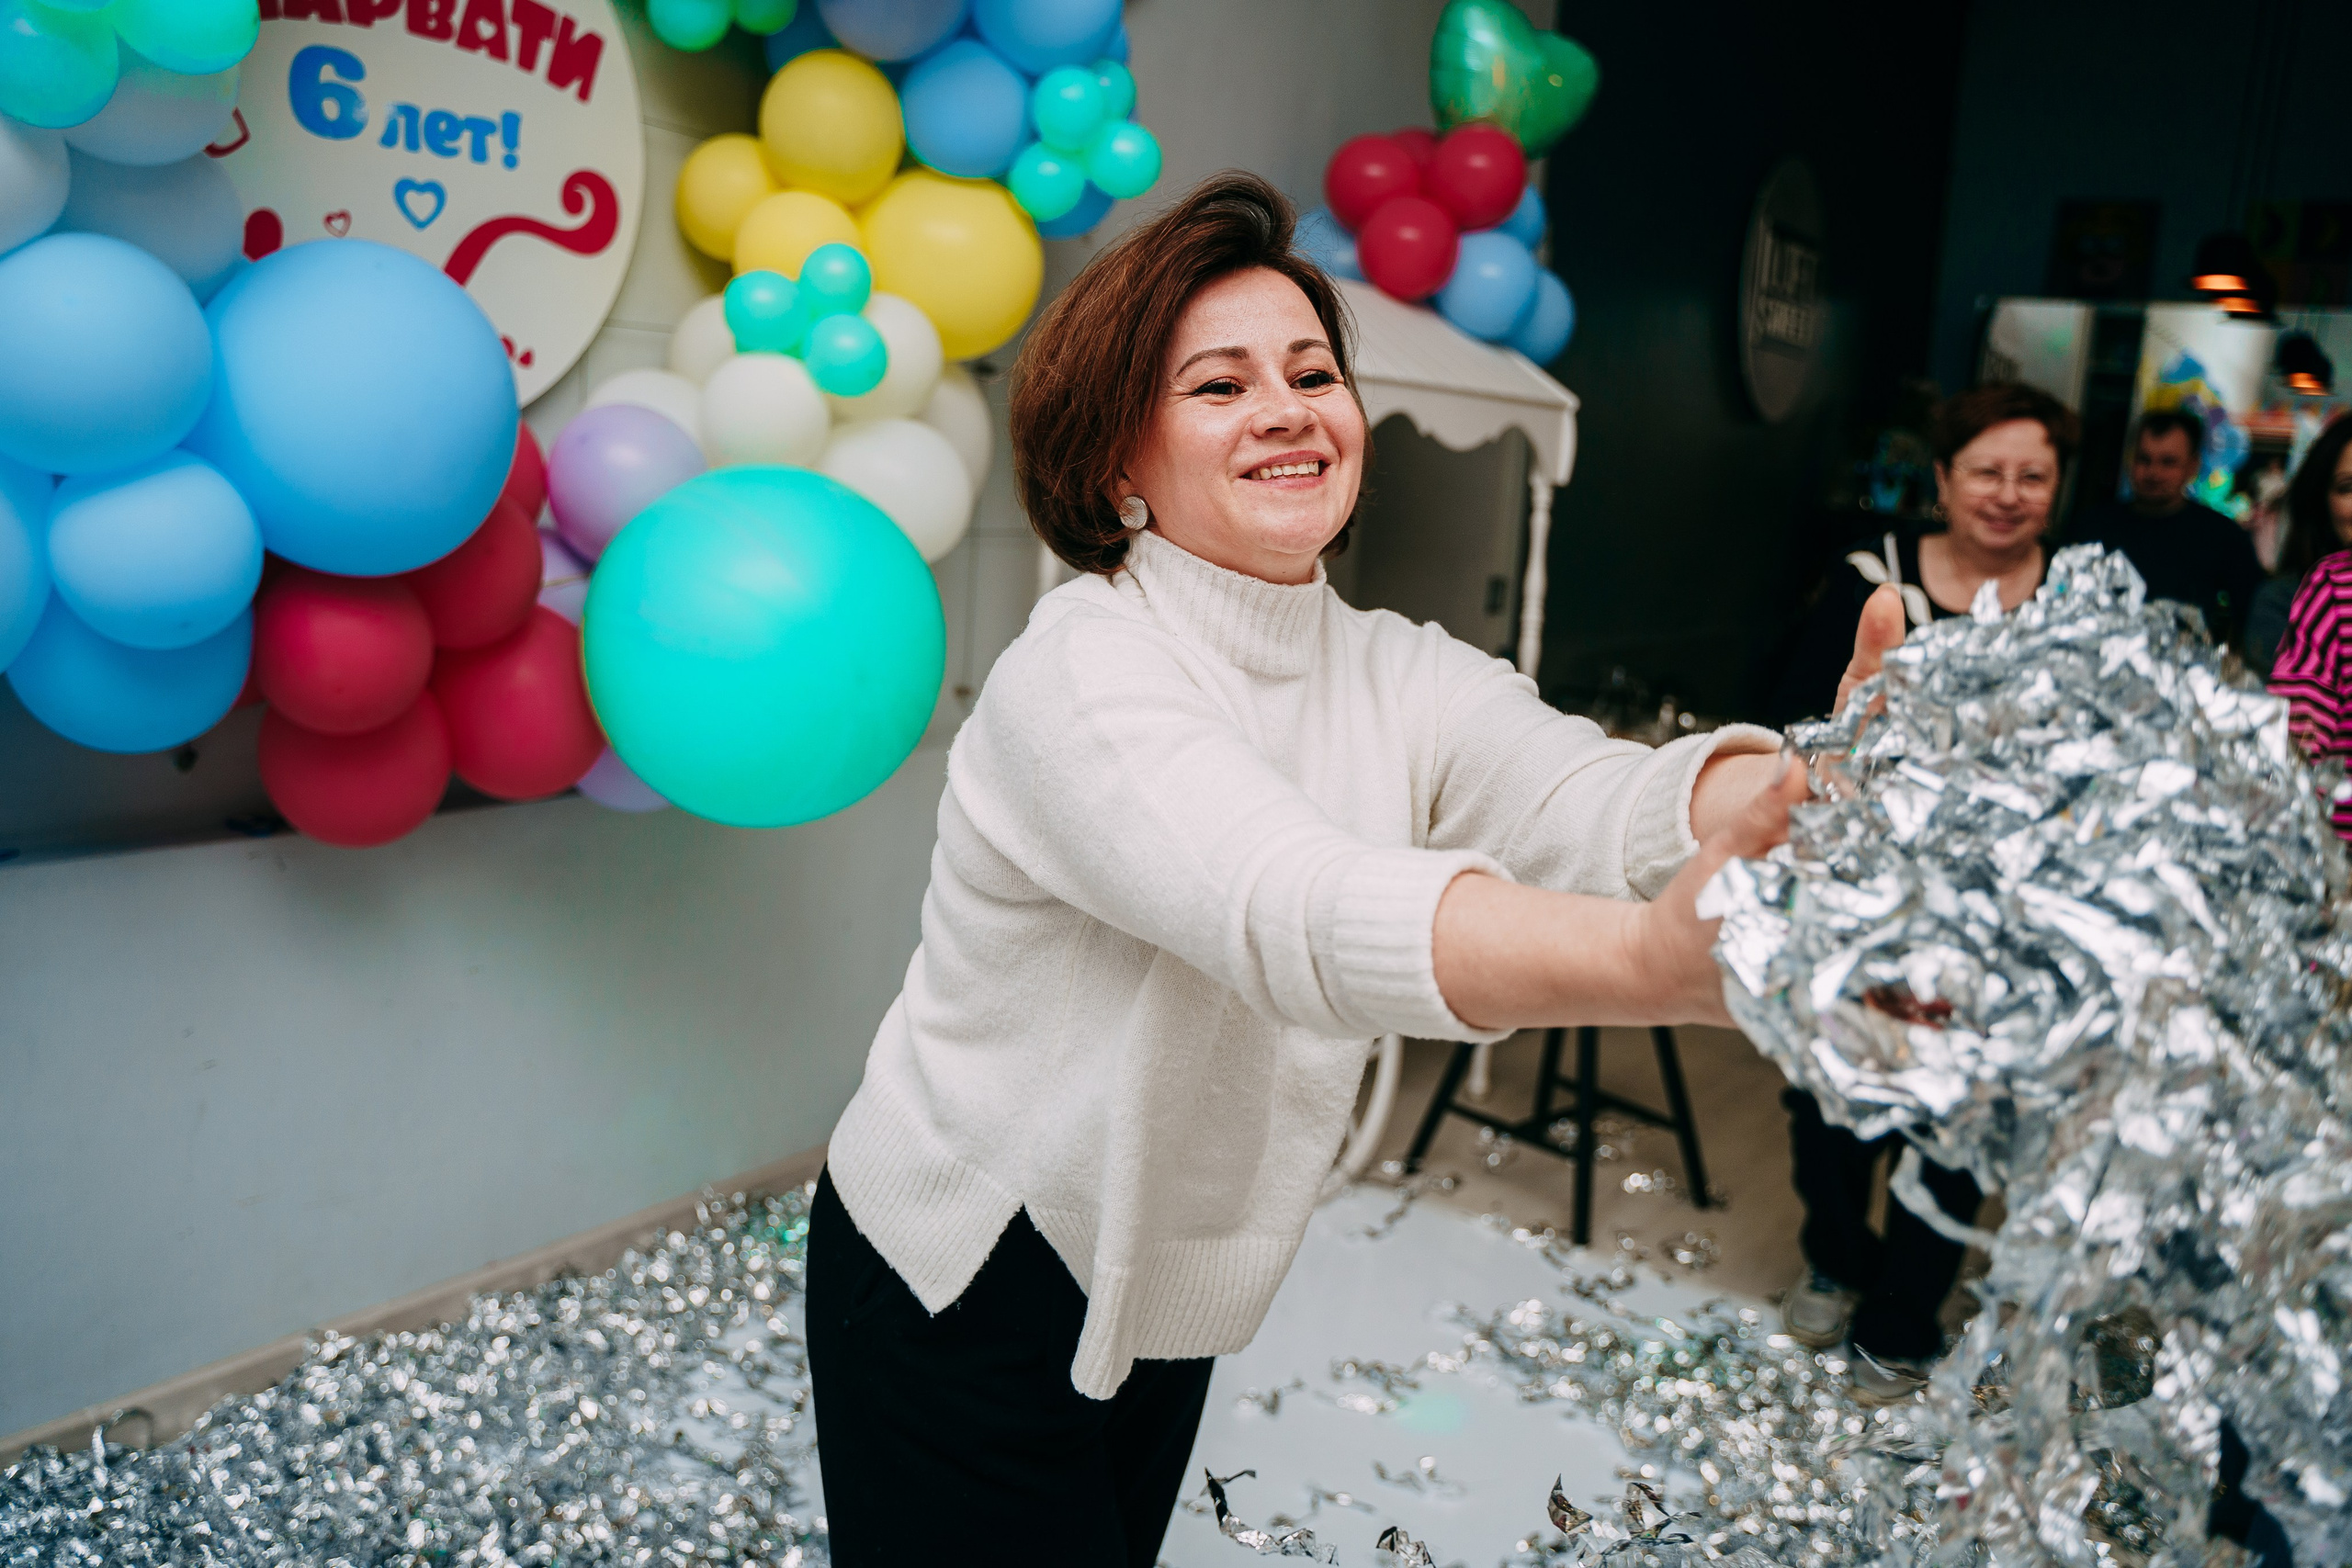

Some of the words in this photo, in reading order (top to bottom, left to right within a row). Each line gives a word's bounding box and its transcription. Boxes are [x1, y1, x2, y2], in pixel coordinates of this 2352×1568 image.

[260, 0, 605, 104] РВАТИ
[288, 44, 368, 140] 6
[379, 103, 522, 171] лет!
